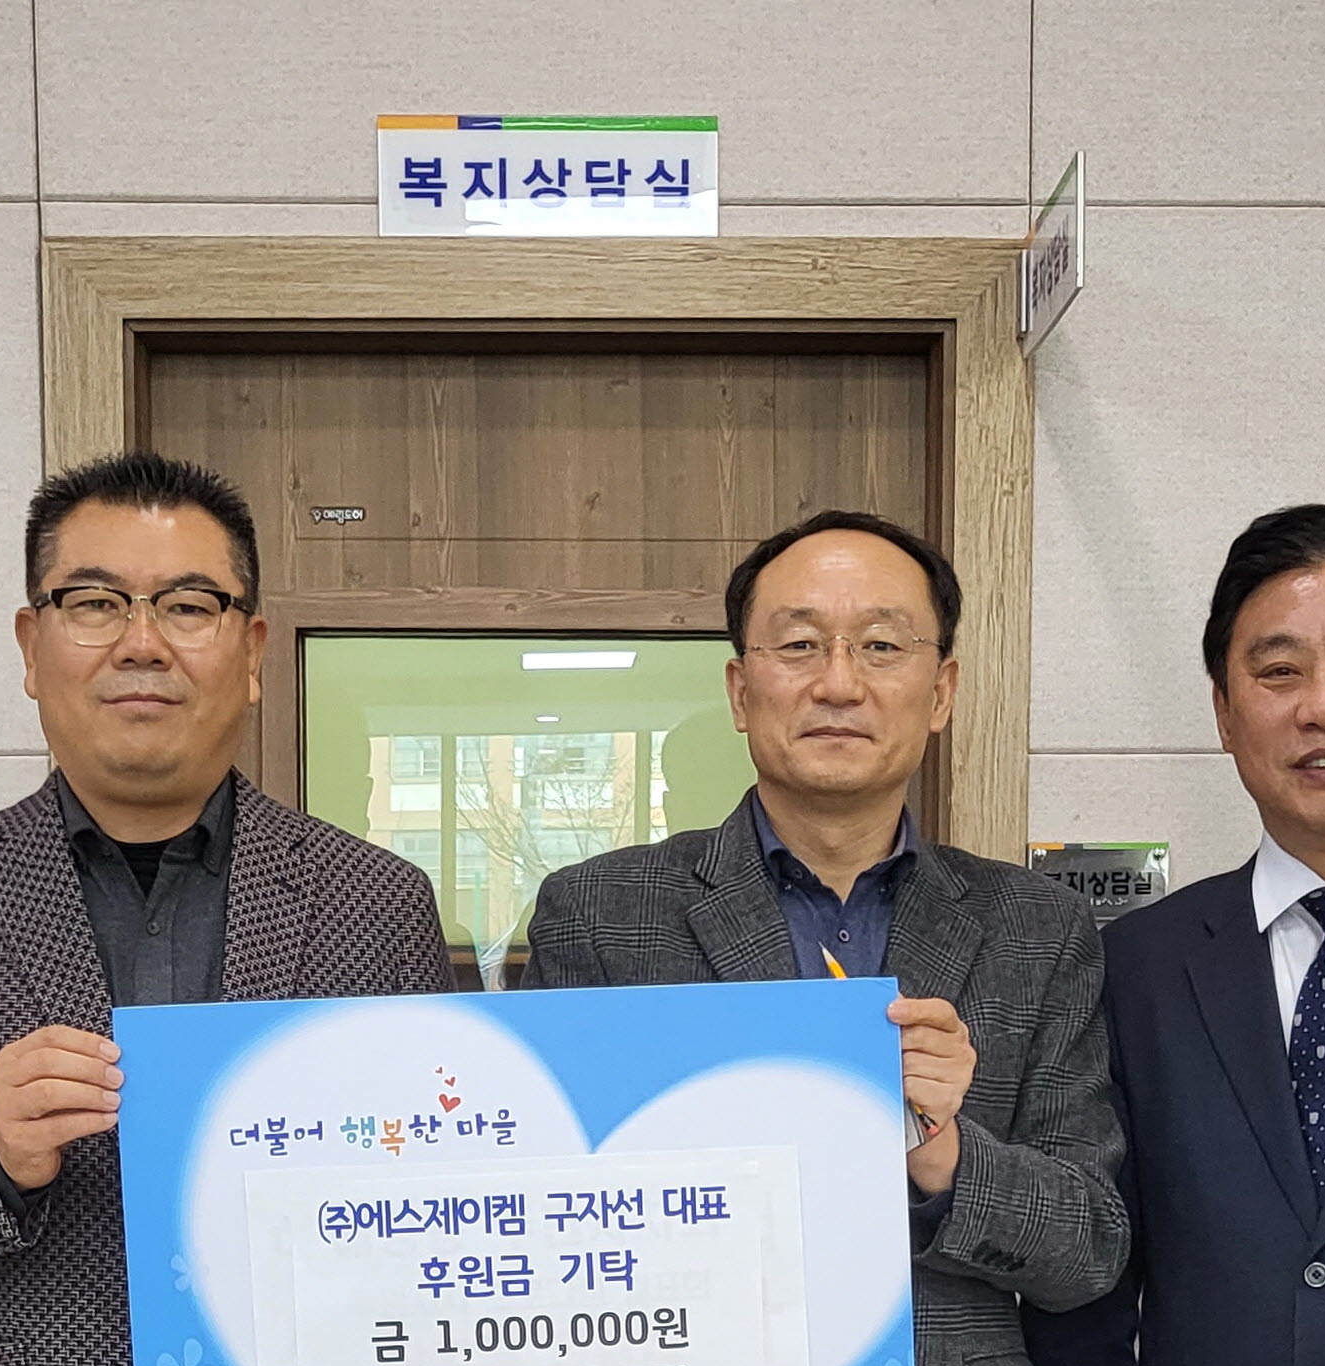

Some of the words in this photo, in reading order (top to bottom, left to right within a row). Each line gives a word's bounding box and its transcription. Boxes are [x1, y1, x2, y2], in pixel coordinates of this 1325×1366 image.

[399, 157, 691, 208] 복지상담실
[230, 1117, 323, 1156] 더불어
[340, 1114, 442, 1156] 행복한
[457, 1109, 516, 1145] 마을
[544, 1188, 645, 1232] 구자선
[662, 1186, 731, 1225] 대표
[418, 1254, 534, 1298] 후원금
[559, 1249, 638, 1291] 기탁
[372, 1321, 409, 1362] 금
[437, 1308, 689, 1361] 1,000,000원
